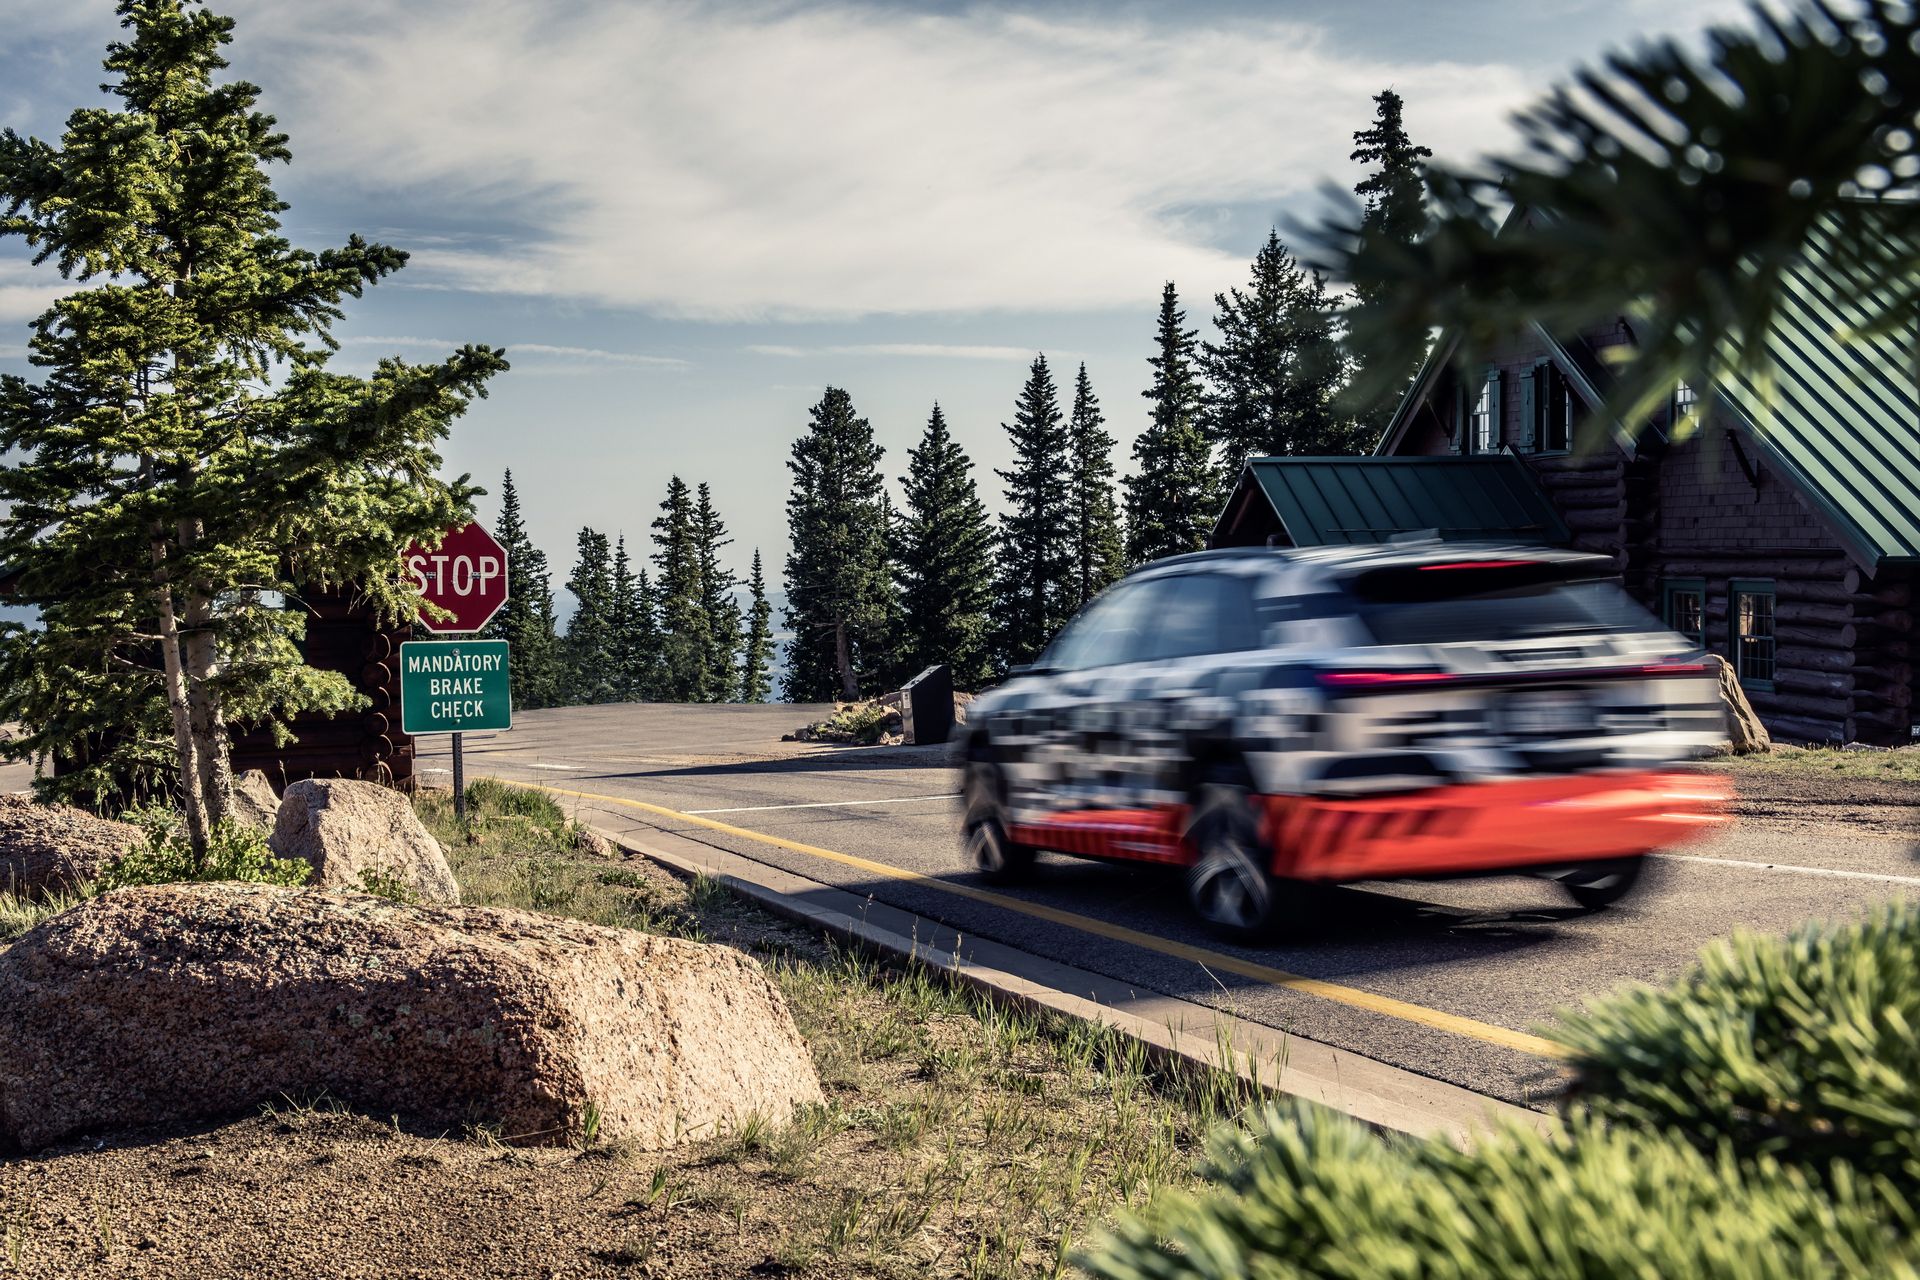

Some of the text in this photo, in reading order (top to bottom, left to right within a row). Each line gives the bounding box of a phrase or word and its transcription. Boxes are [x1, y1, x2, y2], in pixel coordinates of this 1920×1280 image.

[408, 555, 499, 596] STOP
[408, 655, 501, 673] MANDATORY
[430, 678, 483, 695] BRAKE
[431, 700, 484, 718] CHECK
